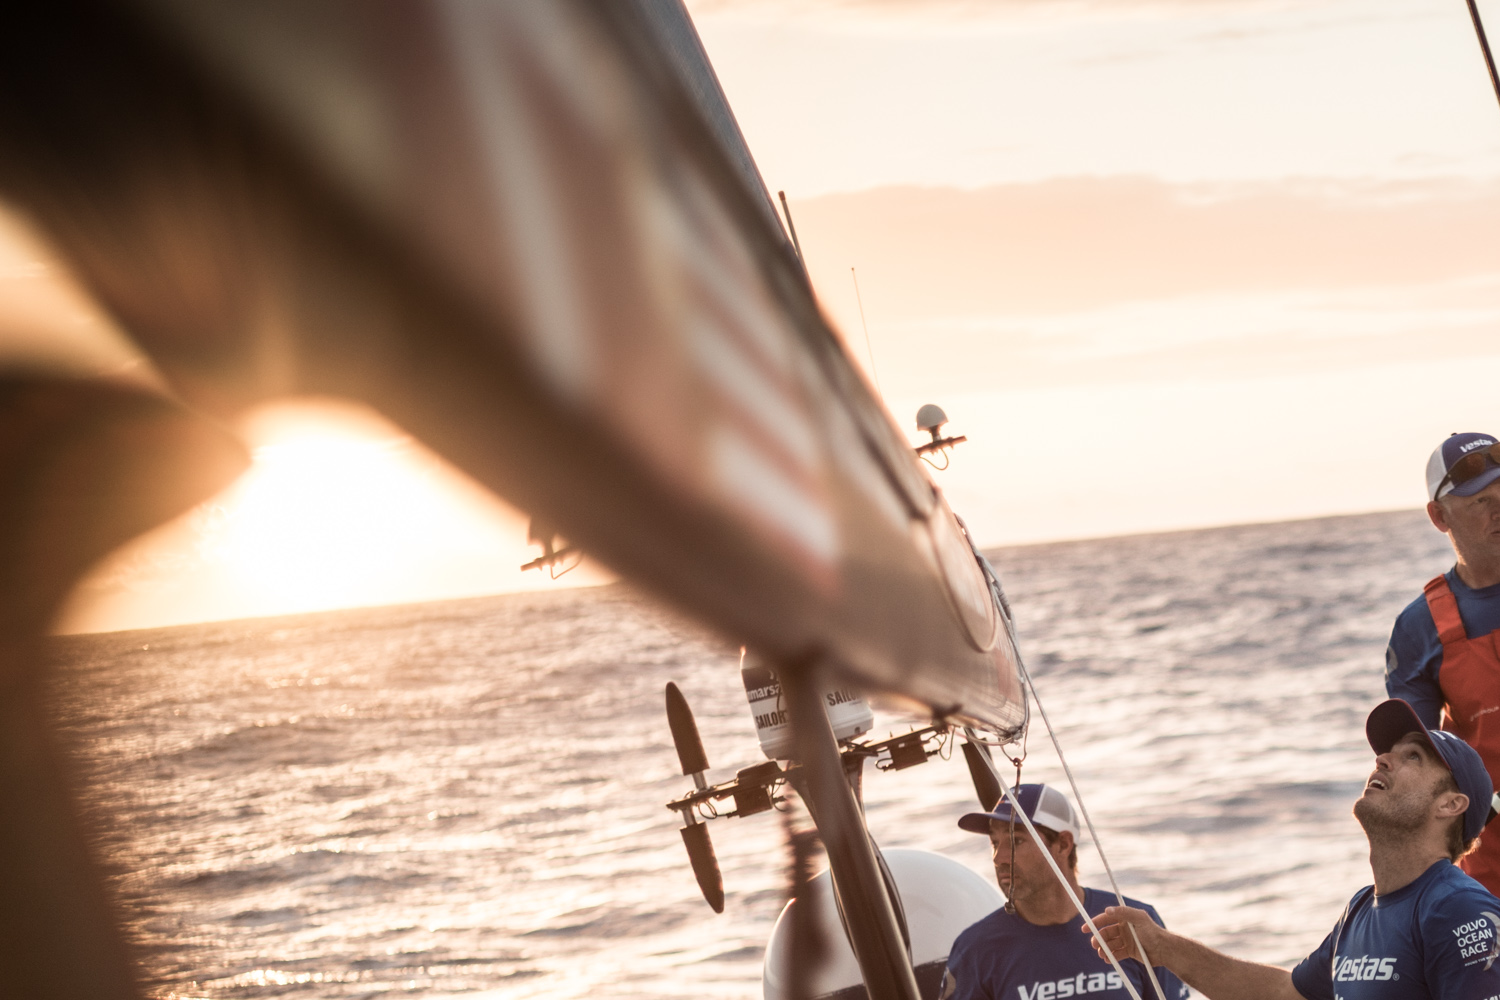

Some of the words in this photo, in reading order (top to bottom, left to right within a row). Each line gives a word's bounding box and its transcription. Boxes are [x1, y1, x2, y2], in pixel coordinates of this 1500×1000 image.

[1452, 918, 1488, 938] VOLVO
[1457, 928, 1493, 948] OCEAN
[1460, 941, 1489, 959] RACE
